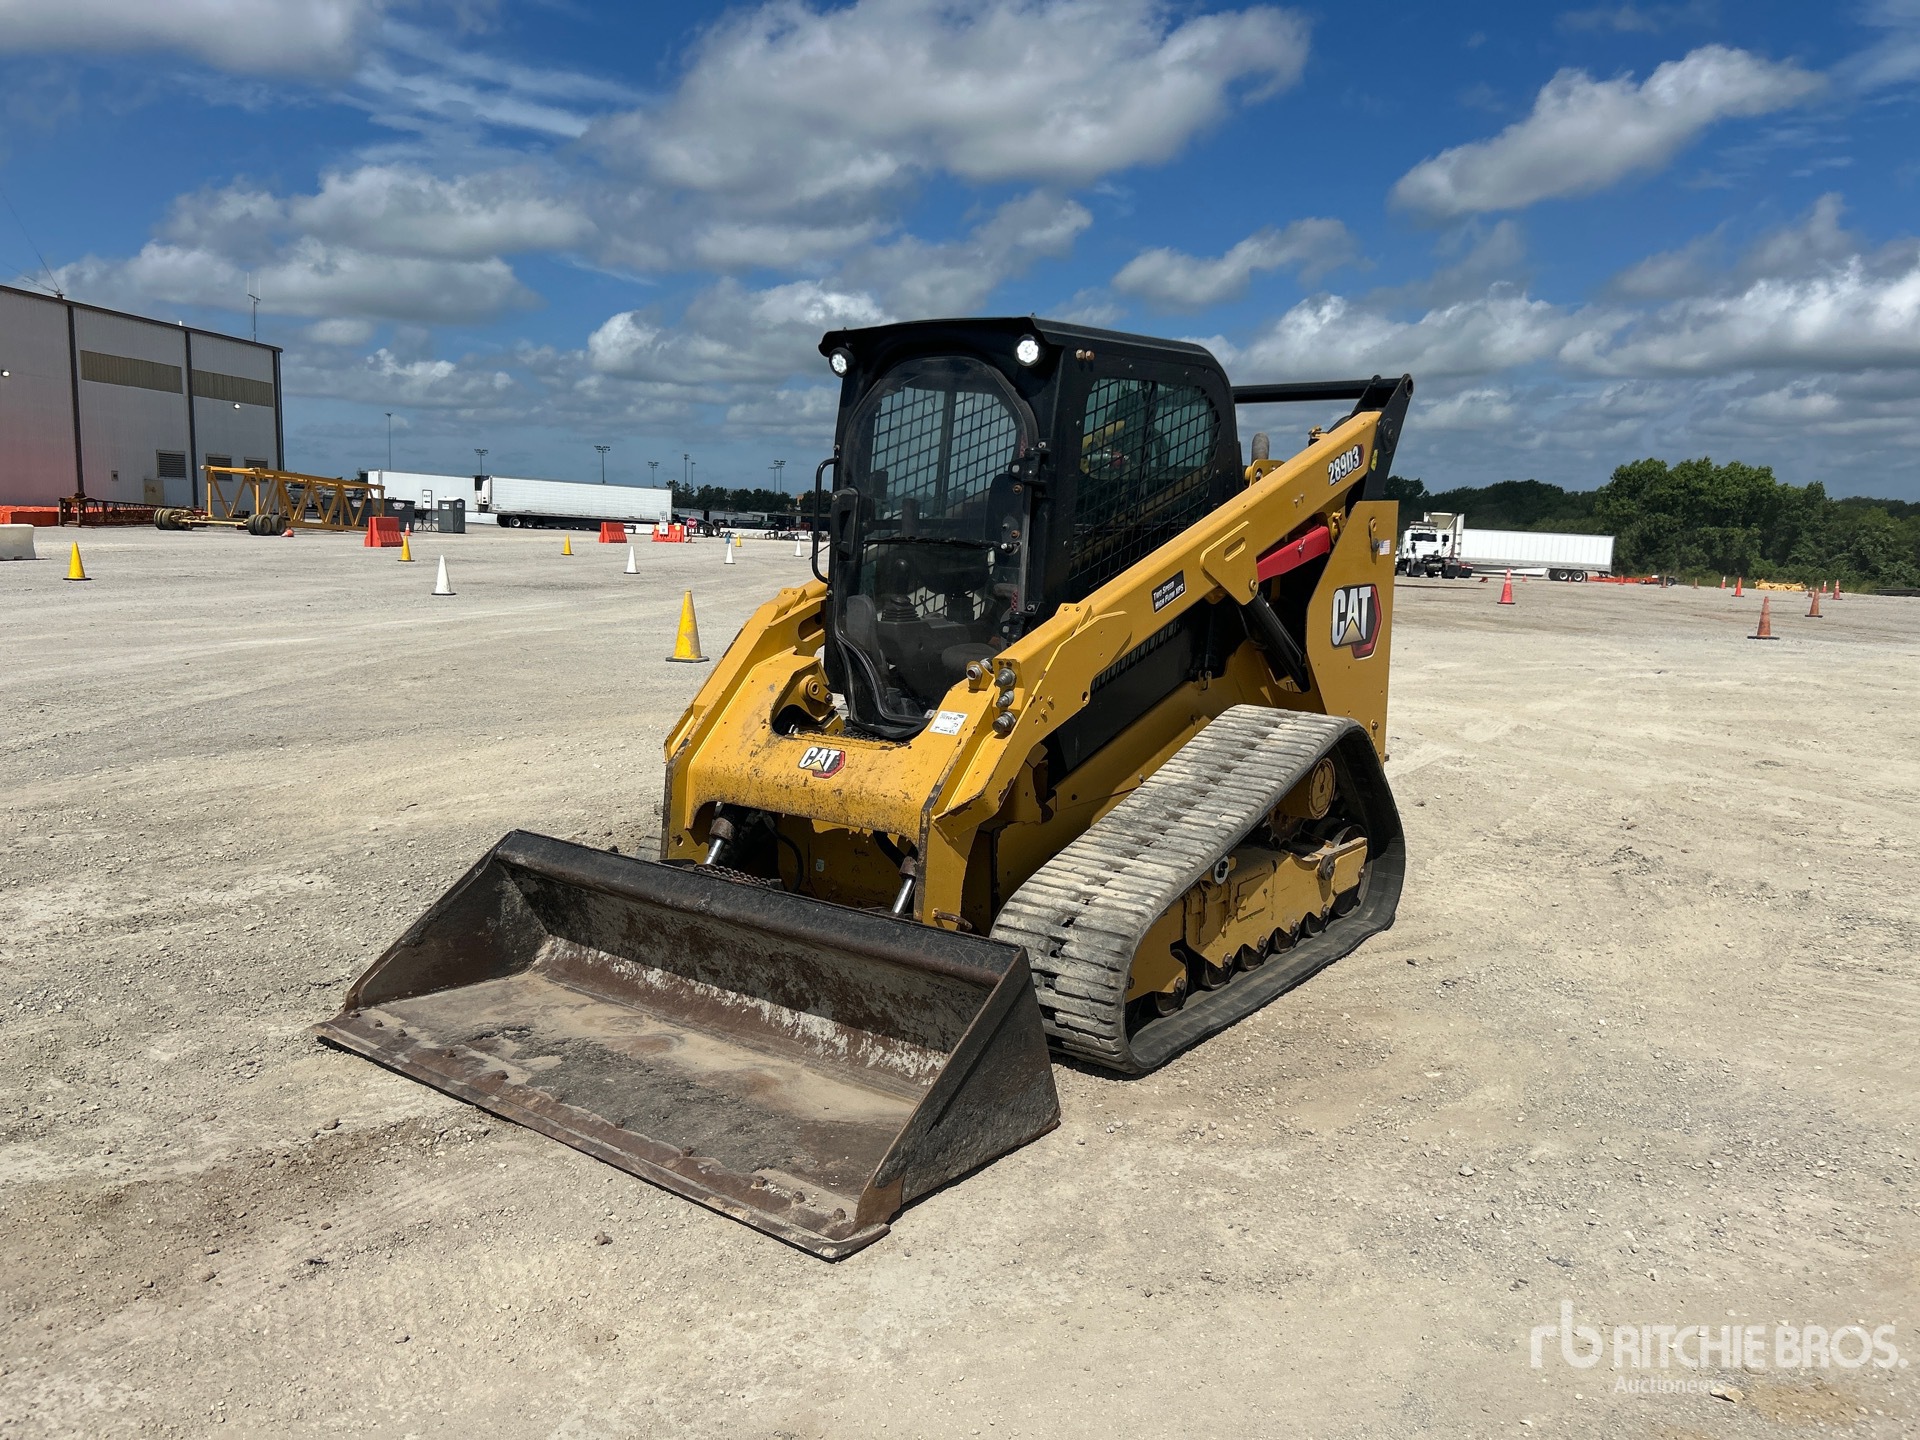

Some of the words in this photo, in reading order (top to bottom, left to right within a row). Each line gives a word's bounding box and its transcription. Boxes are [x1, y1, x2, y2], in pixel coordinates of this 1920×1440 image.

[1328, 445, 1360, 485] 289D3
[1331, 585, 1372, 646] CAT
[798, 746, 841, 772] CAT
